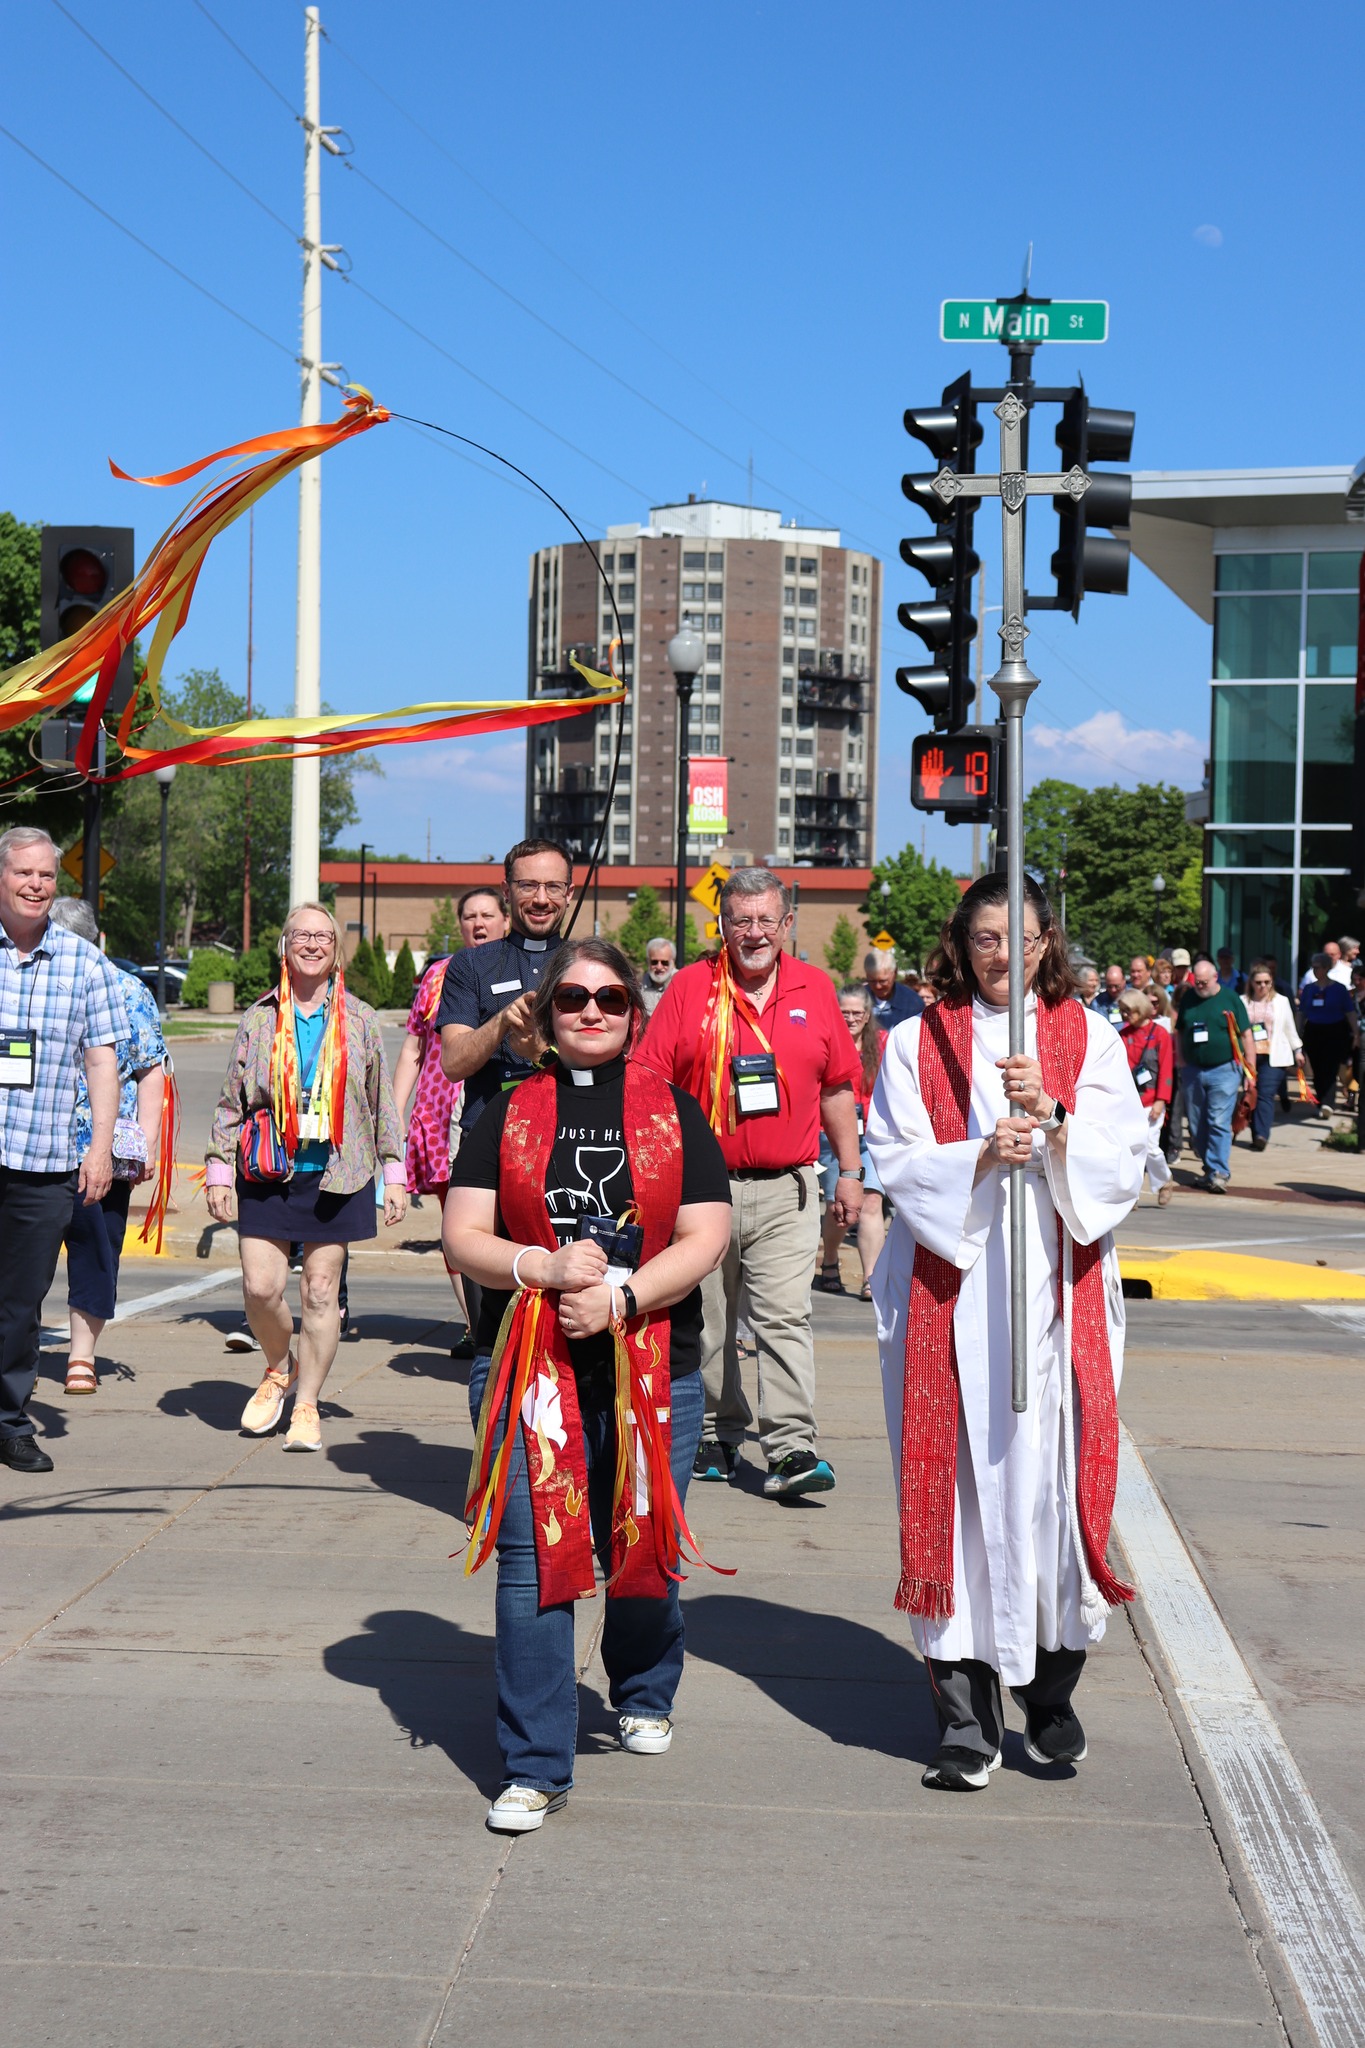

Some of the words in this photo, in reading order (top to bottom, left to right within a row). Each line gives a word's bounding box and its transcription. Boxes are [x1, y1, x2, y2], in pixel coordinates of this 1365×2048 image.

[959, 312, 970, 329] N
[982, 305, 1049, 336] Main
[1068, 314, 1084, 329] St
[693, 786, 723, 806] OSH
[693, 806, 723, 822] KOSH
[558, 1126, 596, 1140] JUST
